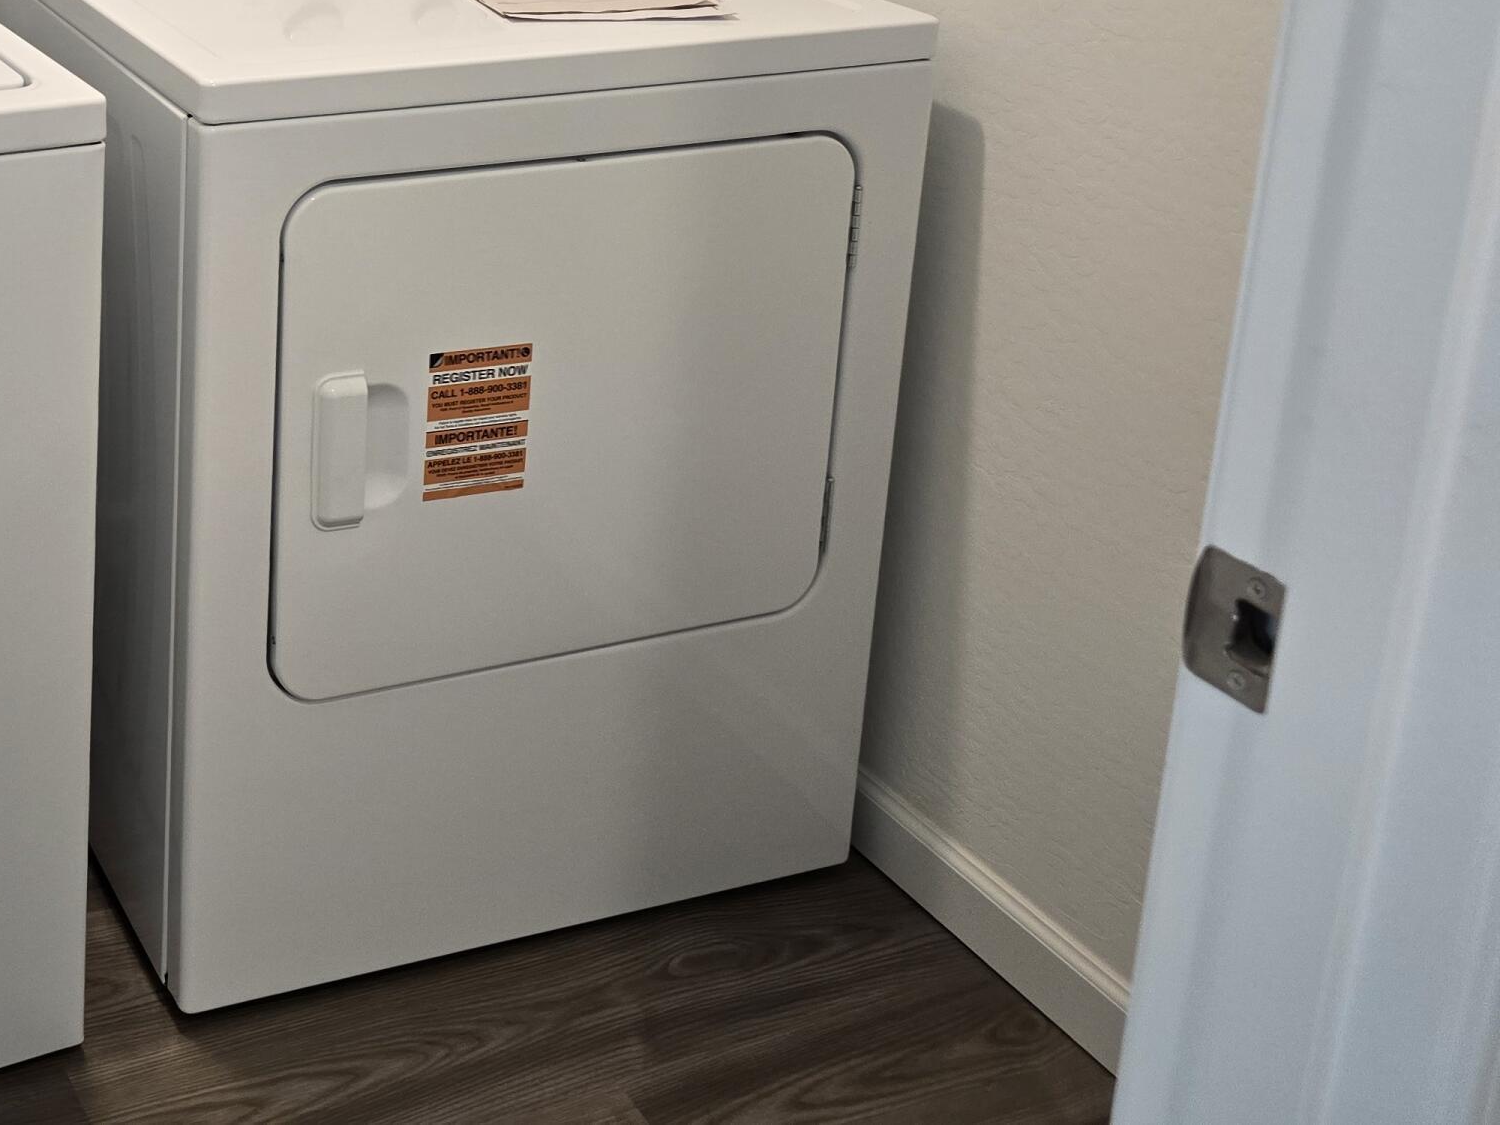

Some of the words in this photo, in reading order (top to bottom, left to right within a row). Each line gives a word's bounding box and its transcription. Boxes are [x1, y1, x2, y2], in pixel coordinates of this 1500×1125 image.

[444, 348, 520, 366] IMPORTANT!
[432, 368, 496, 384] REGISTER
[498, 364, 529, 377] NOW
[431, 389, 458, 400] CALL
[460, 381, 528, 397] 1-888-900-3381
[460, 397, 486, 406] REGISTER
[434, 425, 518, 445] IMPORTANTE!
[427, 457, 461, 468] APPELEZ
[462, 456, 472, 464] LE
